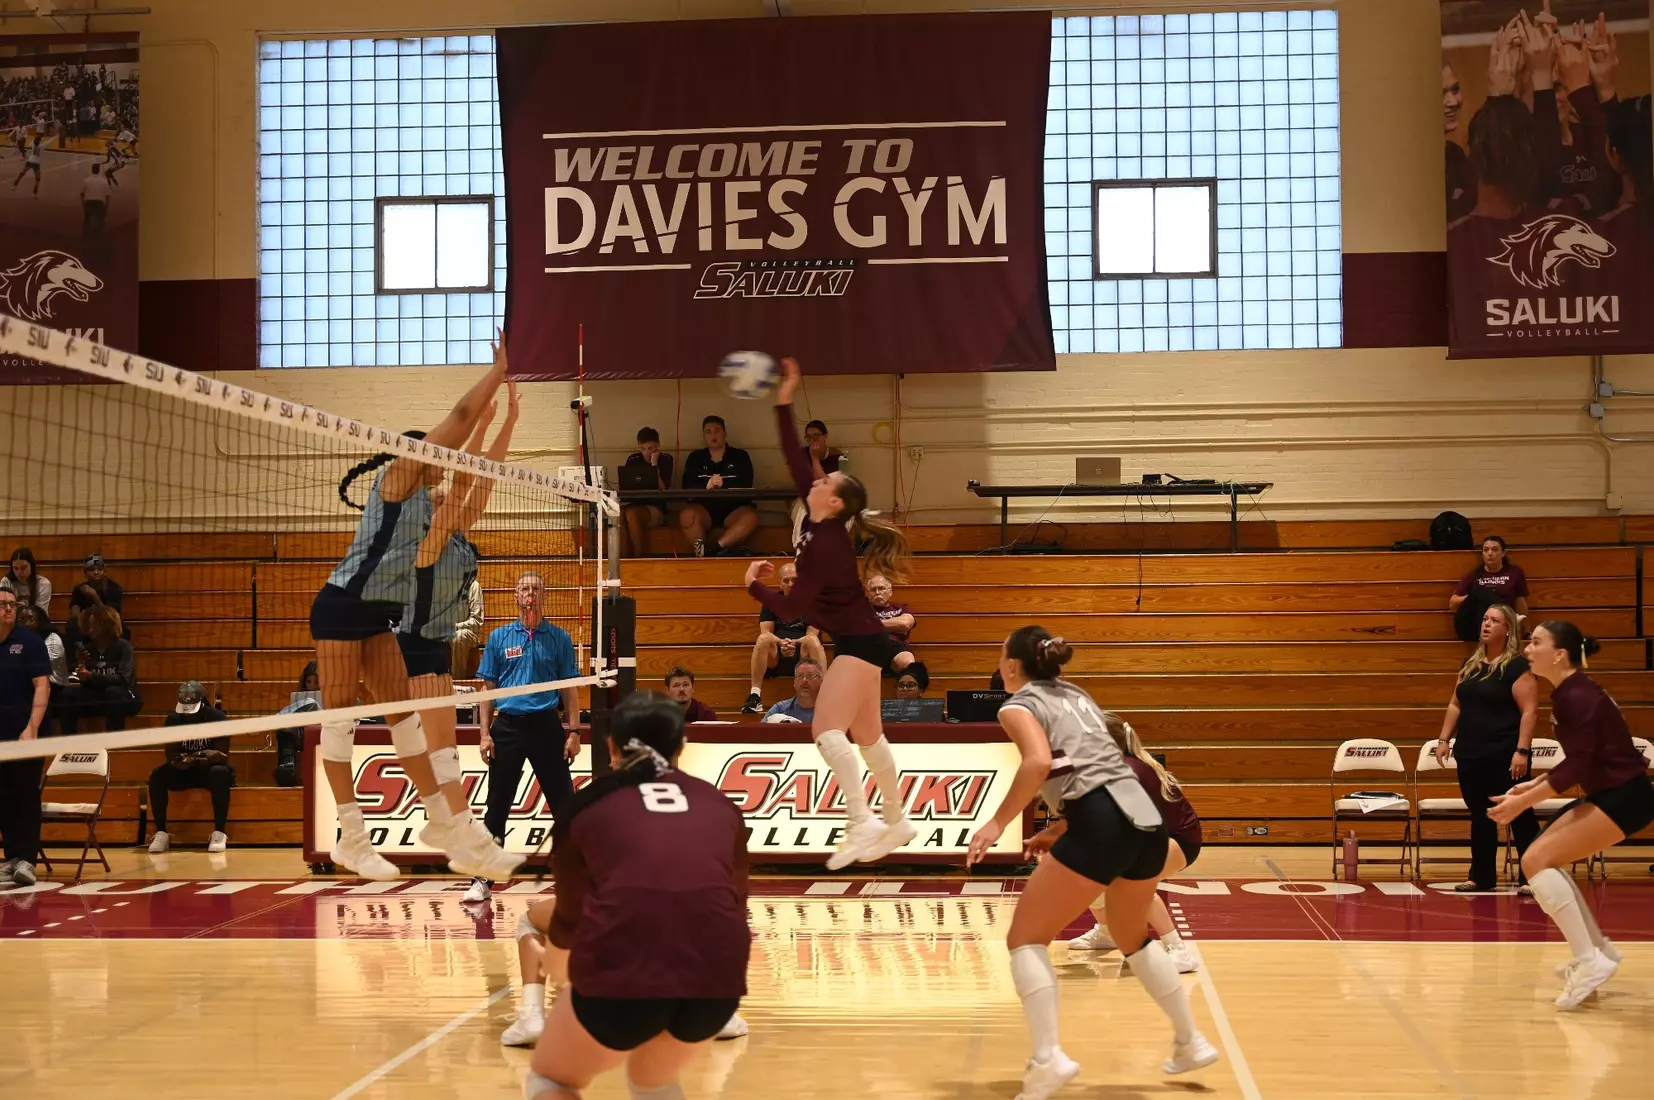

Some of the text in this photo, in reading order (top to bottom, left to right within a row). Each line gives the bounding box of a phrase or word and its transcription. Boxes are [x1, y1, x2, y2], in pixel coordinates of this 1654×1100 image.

[554, 138, 914, 183] WELCOME TO
[545, 175, 1007, 255] DAVIES GYM
[750, 259, 855, 268] VOLLEYBALL
[693, 262, 854, 299] SALUKI
[1486, 296, 1620, 326] SALUKI
[1507, 327, 1599, 338] VOLLEYBALL
[27, 325, 50, 350] SIU
[89, 345, 110, 367] SIU
[145, 362, 165, 382] SIU
[195, 376, 212, 396] SIU
[240, 389, 255, 408] SIU
[280, 402, 294, 418] SIU
[316, 412, 329, 428] SIU
[348, 422, 360, 437] SIU
[407, 439, 417, 453] SIU
[1344, 747, 1387, 758] SALUKI
[639, 782, 689, 814] 8
